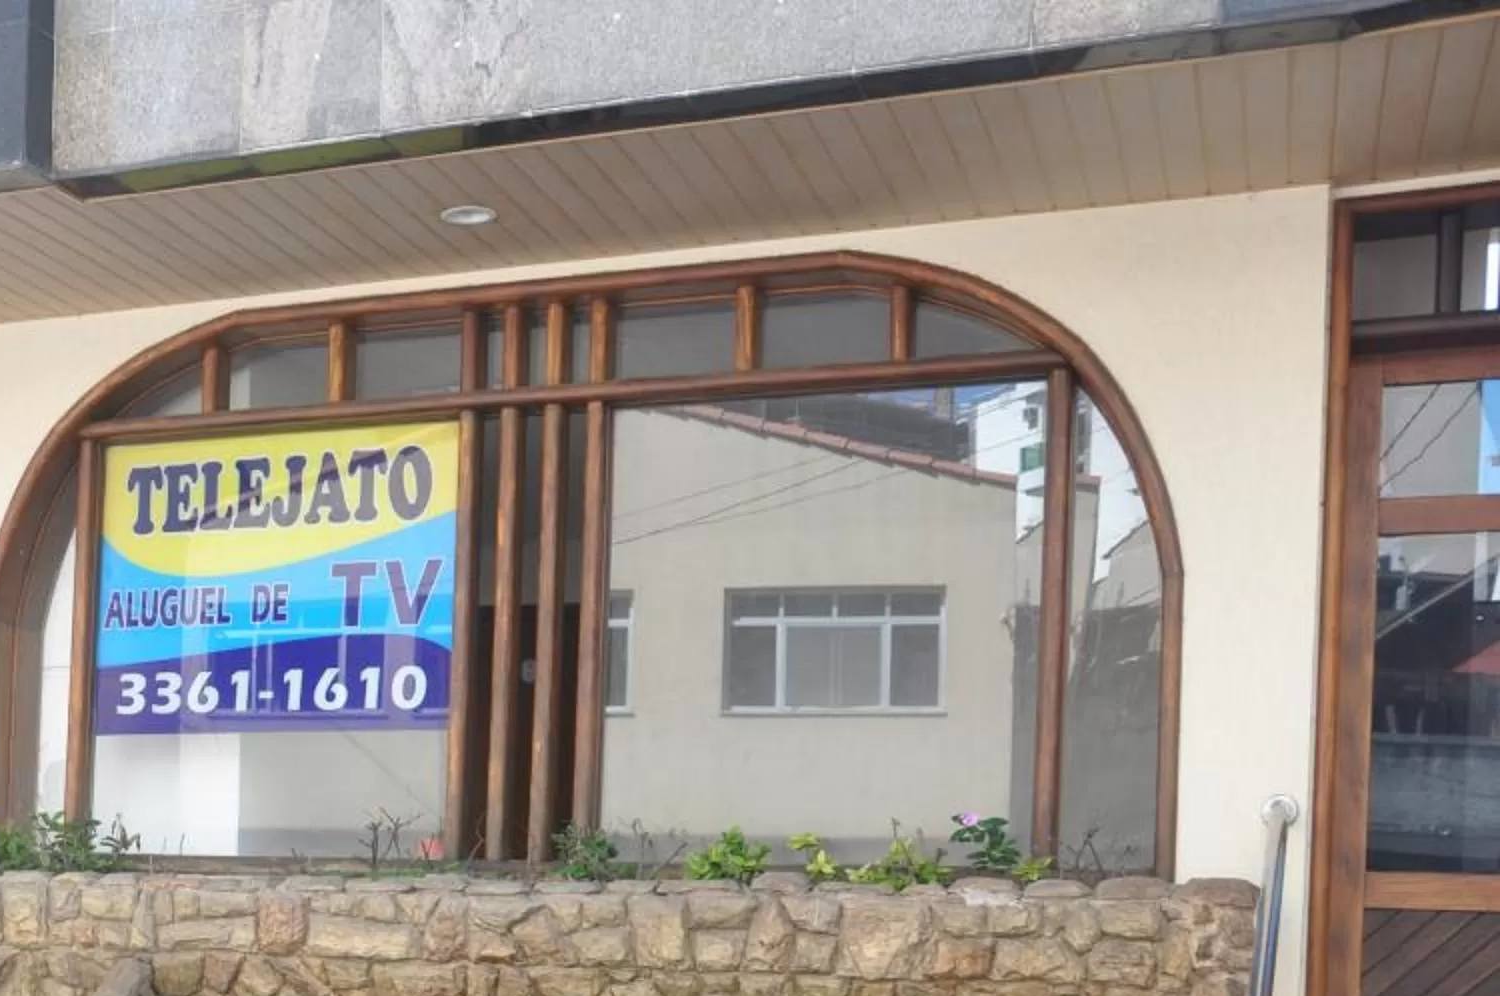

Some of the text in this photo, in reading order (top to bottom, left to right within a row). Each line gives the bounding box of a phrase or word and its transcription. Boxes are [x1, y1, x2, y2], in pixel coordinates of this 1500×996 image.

[126, 445, 434, 537] TELEJATO
[104, 558, 444, 630] ALUGUEL DE TV
[115, 665, 429, 716] 3361-1610
